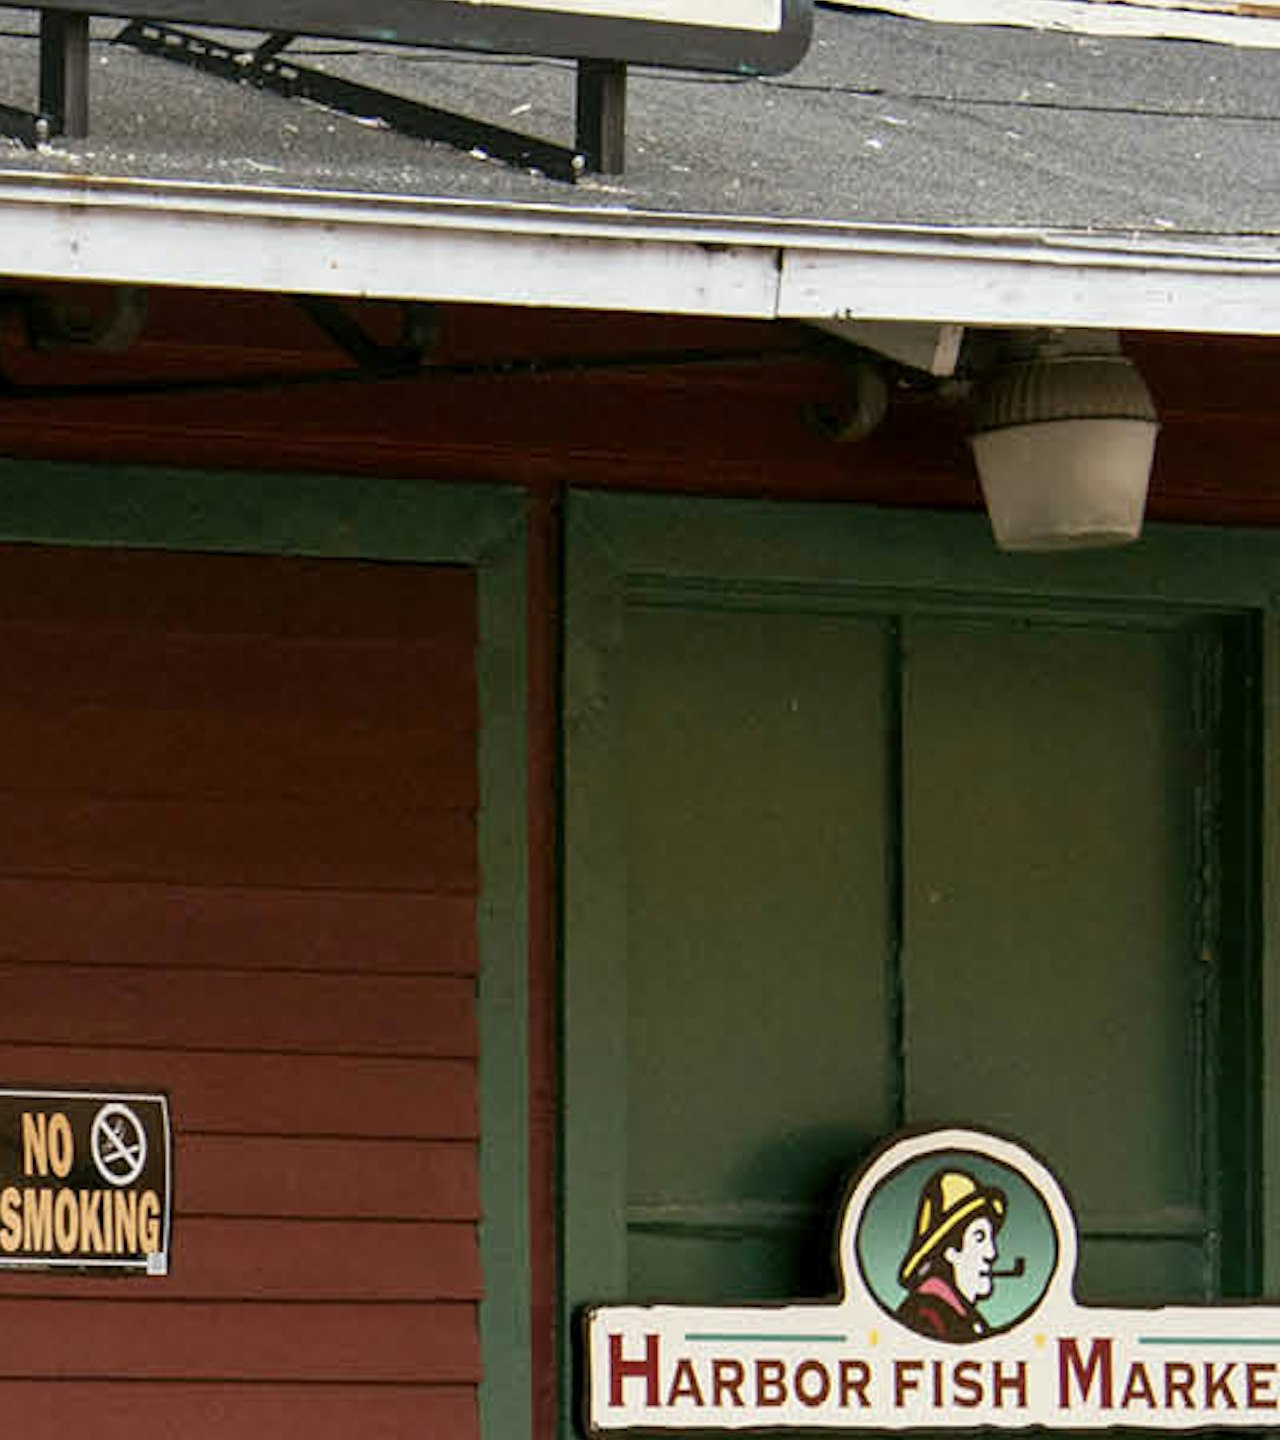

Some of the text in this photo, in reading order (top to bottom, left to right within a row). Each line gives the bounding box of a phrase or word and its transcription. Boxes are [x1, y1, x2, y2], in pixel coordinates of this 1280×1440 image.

[21, 1112, 73, 1178] NO
[608, 1333, 1277, 1408] HARBOR FISH MARKE
